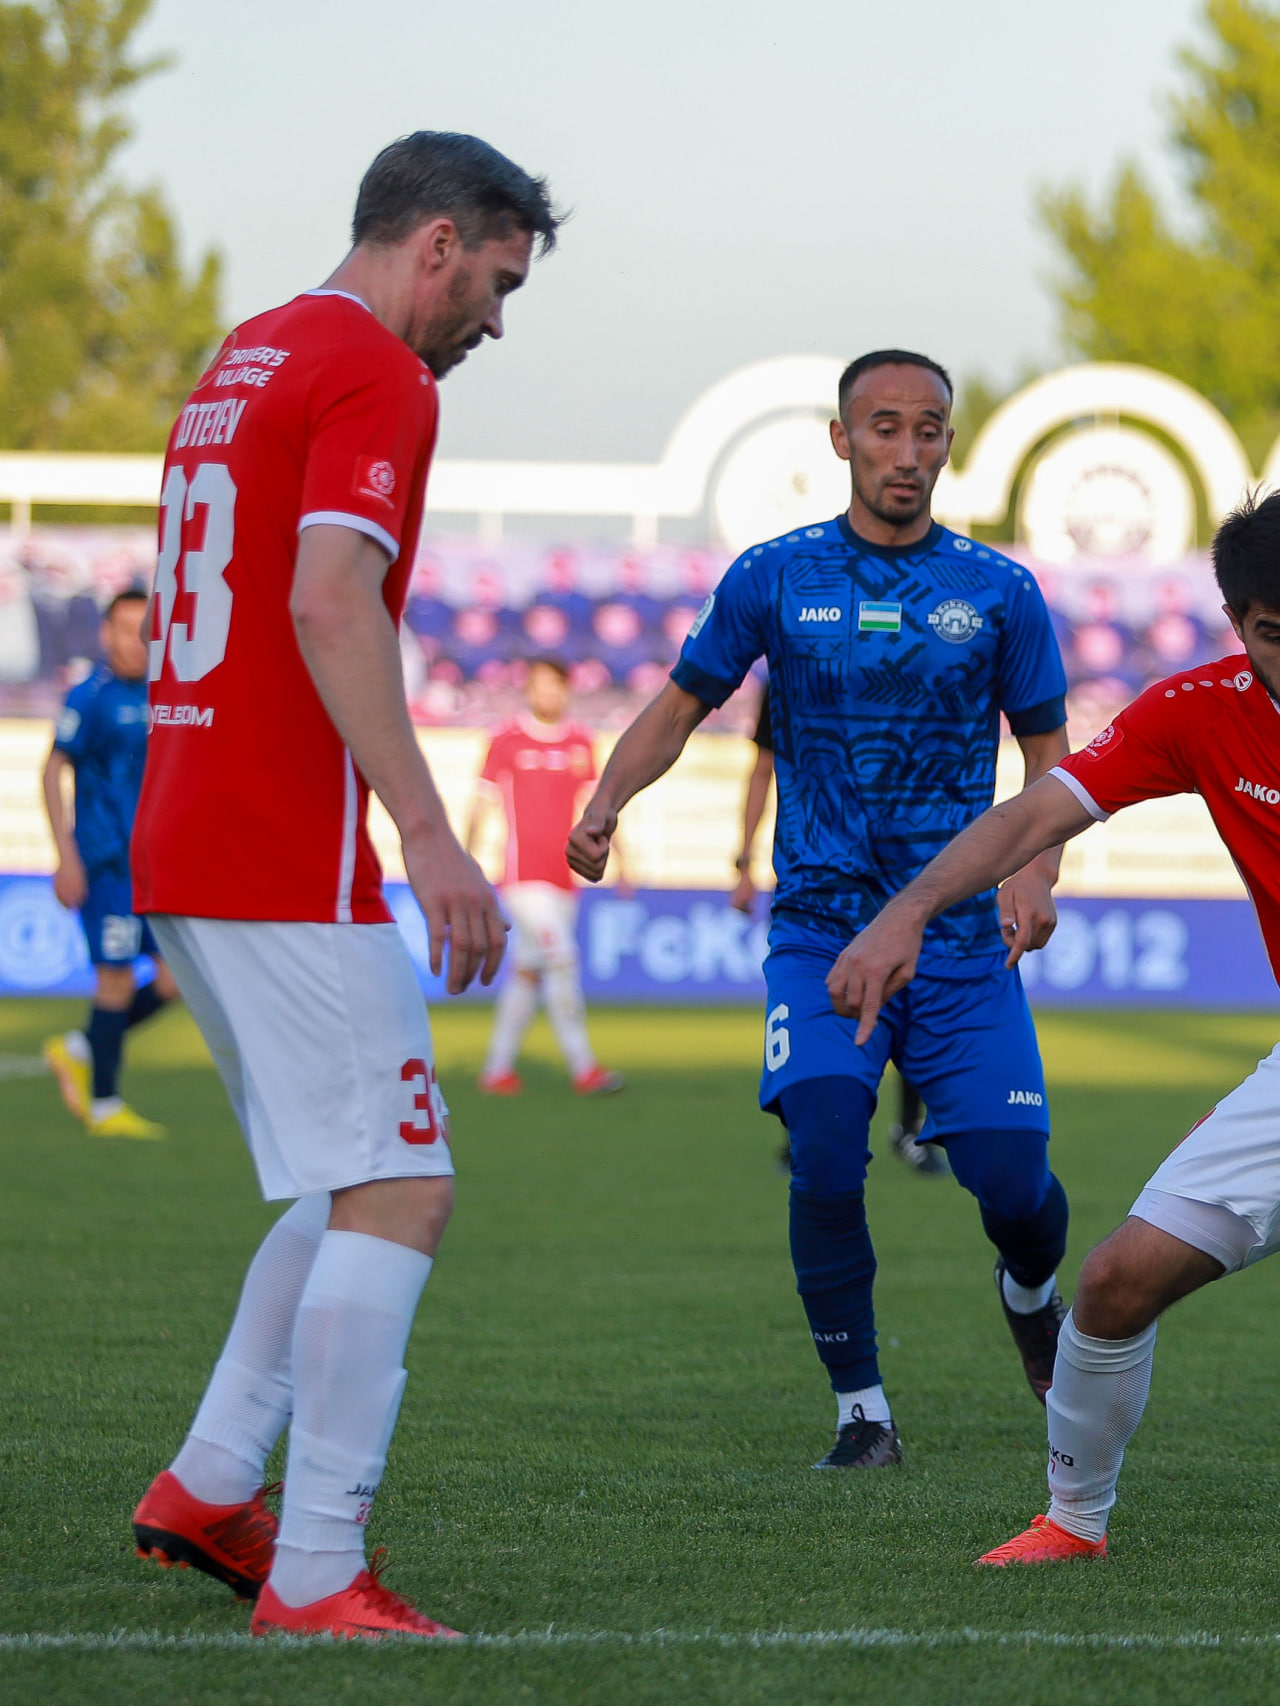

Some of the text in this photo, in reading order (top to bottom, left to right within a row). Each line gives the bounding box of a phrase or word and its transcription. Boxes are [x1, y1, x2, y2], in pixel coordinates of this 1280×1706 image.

[799, 607, 842, 622] JAKO
[1234, 777, 1280, 805] JAKO
[765, 1003, 790, 1072] 6
[1007, 1090, 1043, 1107] JAKO
